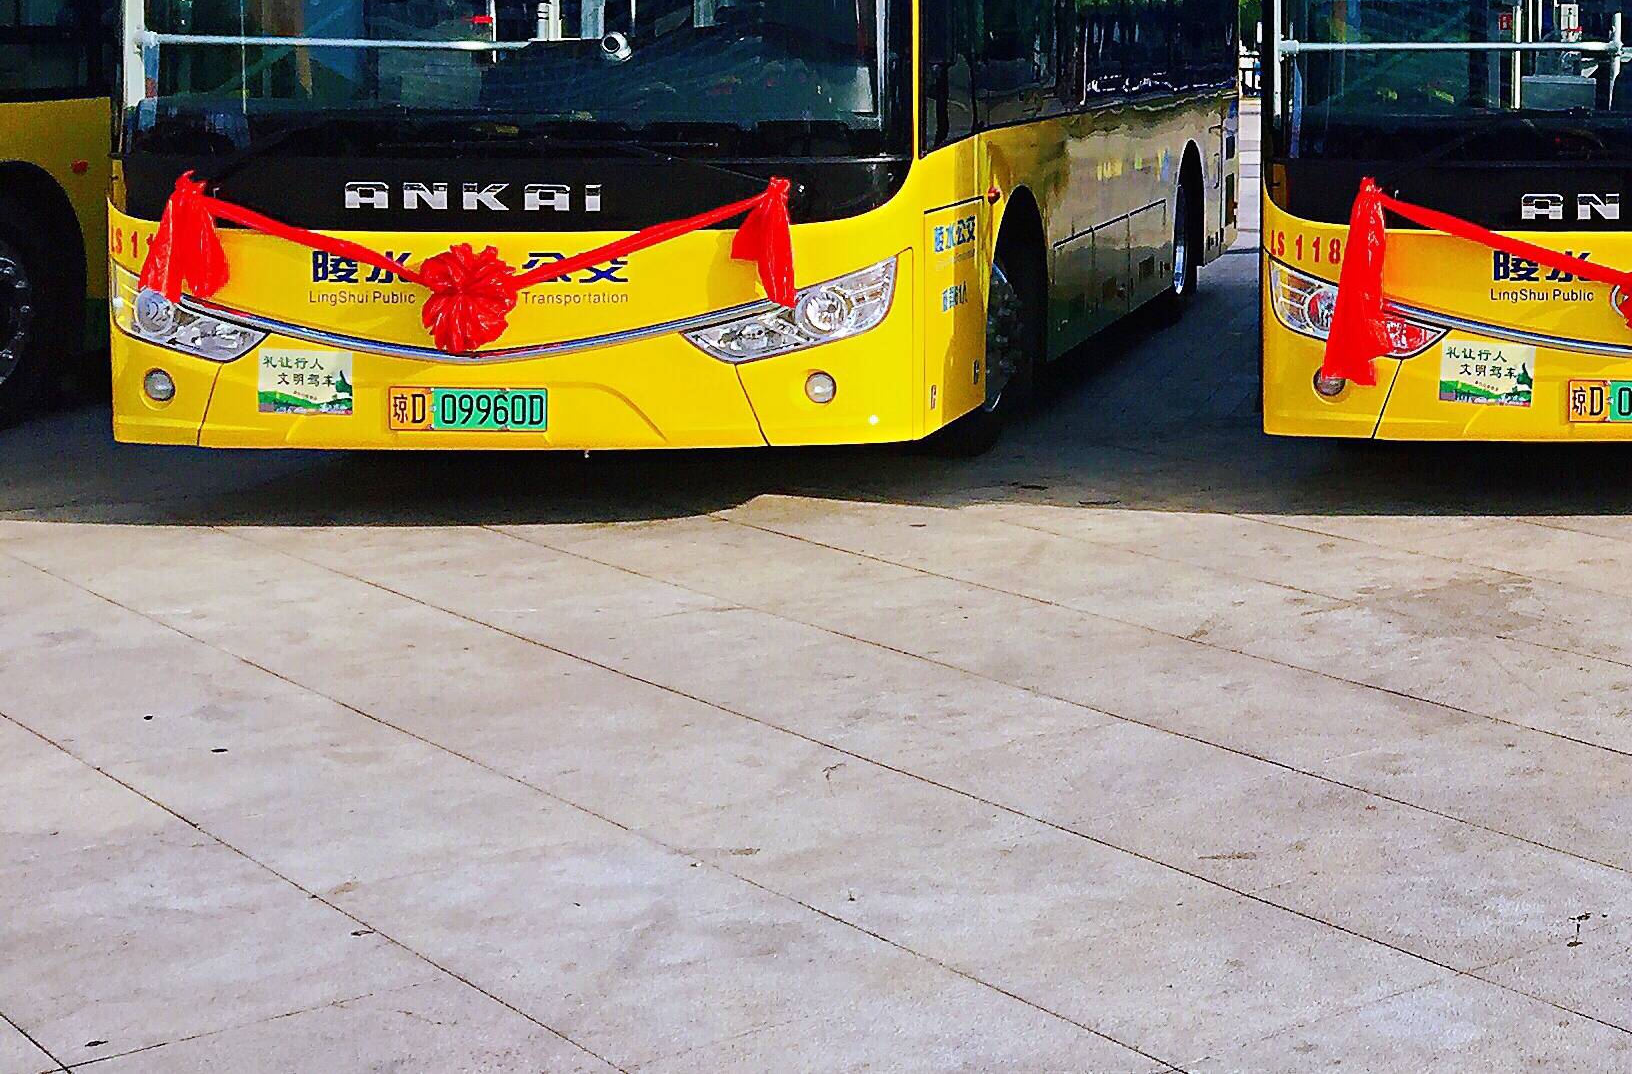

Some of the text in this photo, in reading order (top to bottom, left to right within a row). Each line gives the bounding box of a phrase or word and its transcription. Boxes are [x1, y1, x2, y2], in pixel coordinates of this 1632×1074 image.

[1270, 229, 1285, 257] LS
[309, 289, 629, 306] LingShui Public Transportation
[1490, 288, 1549, 304] LingShui
[1552, 288, 1595, 302] Public
[262, 355, 325, 371] 礼让行人
[1446, 346, 1508, 363] 礼让行人
[277, 371, 336, 388] 文明驾车
[1459, 363, 1518, 379] 文明驾车
[392, 393, 426, 425] 琼D
[1572, 385, 1604, 417] 琼D
